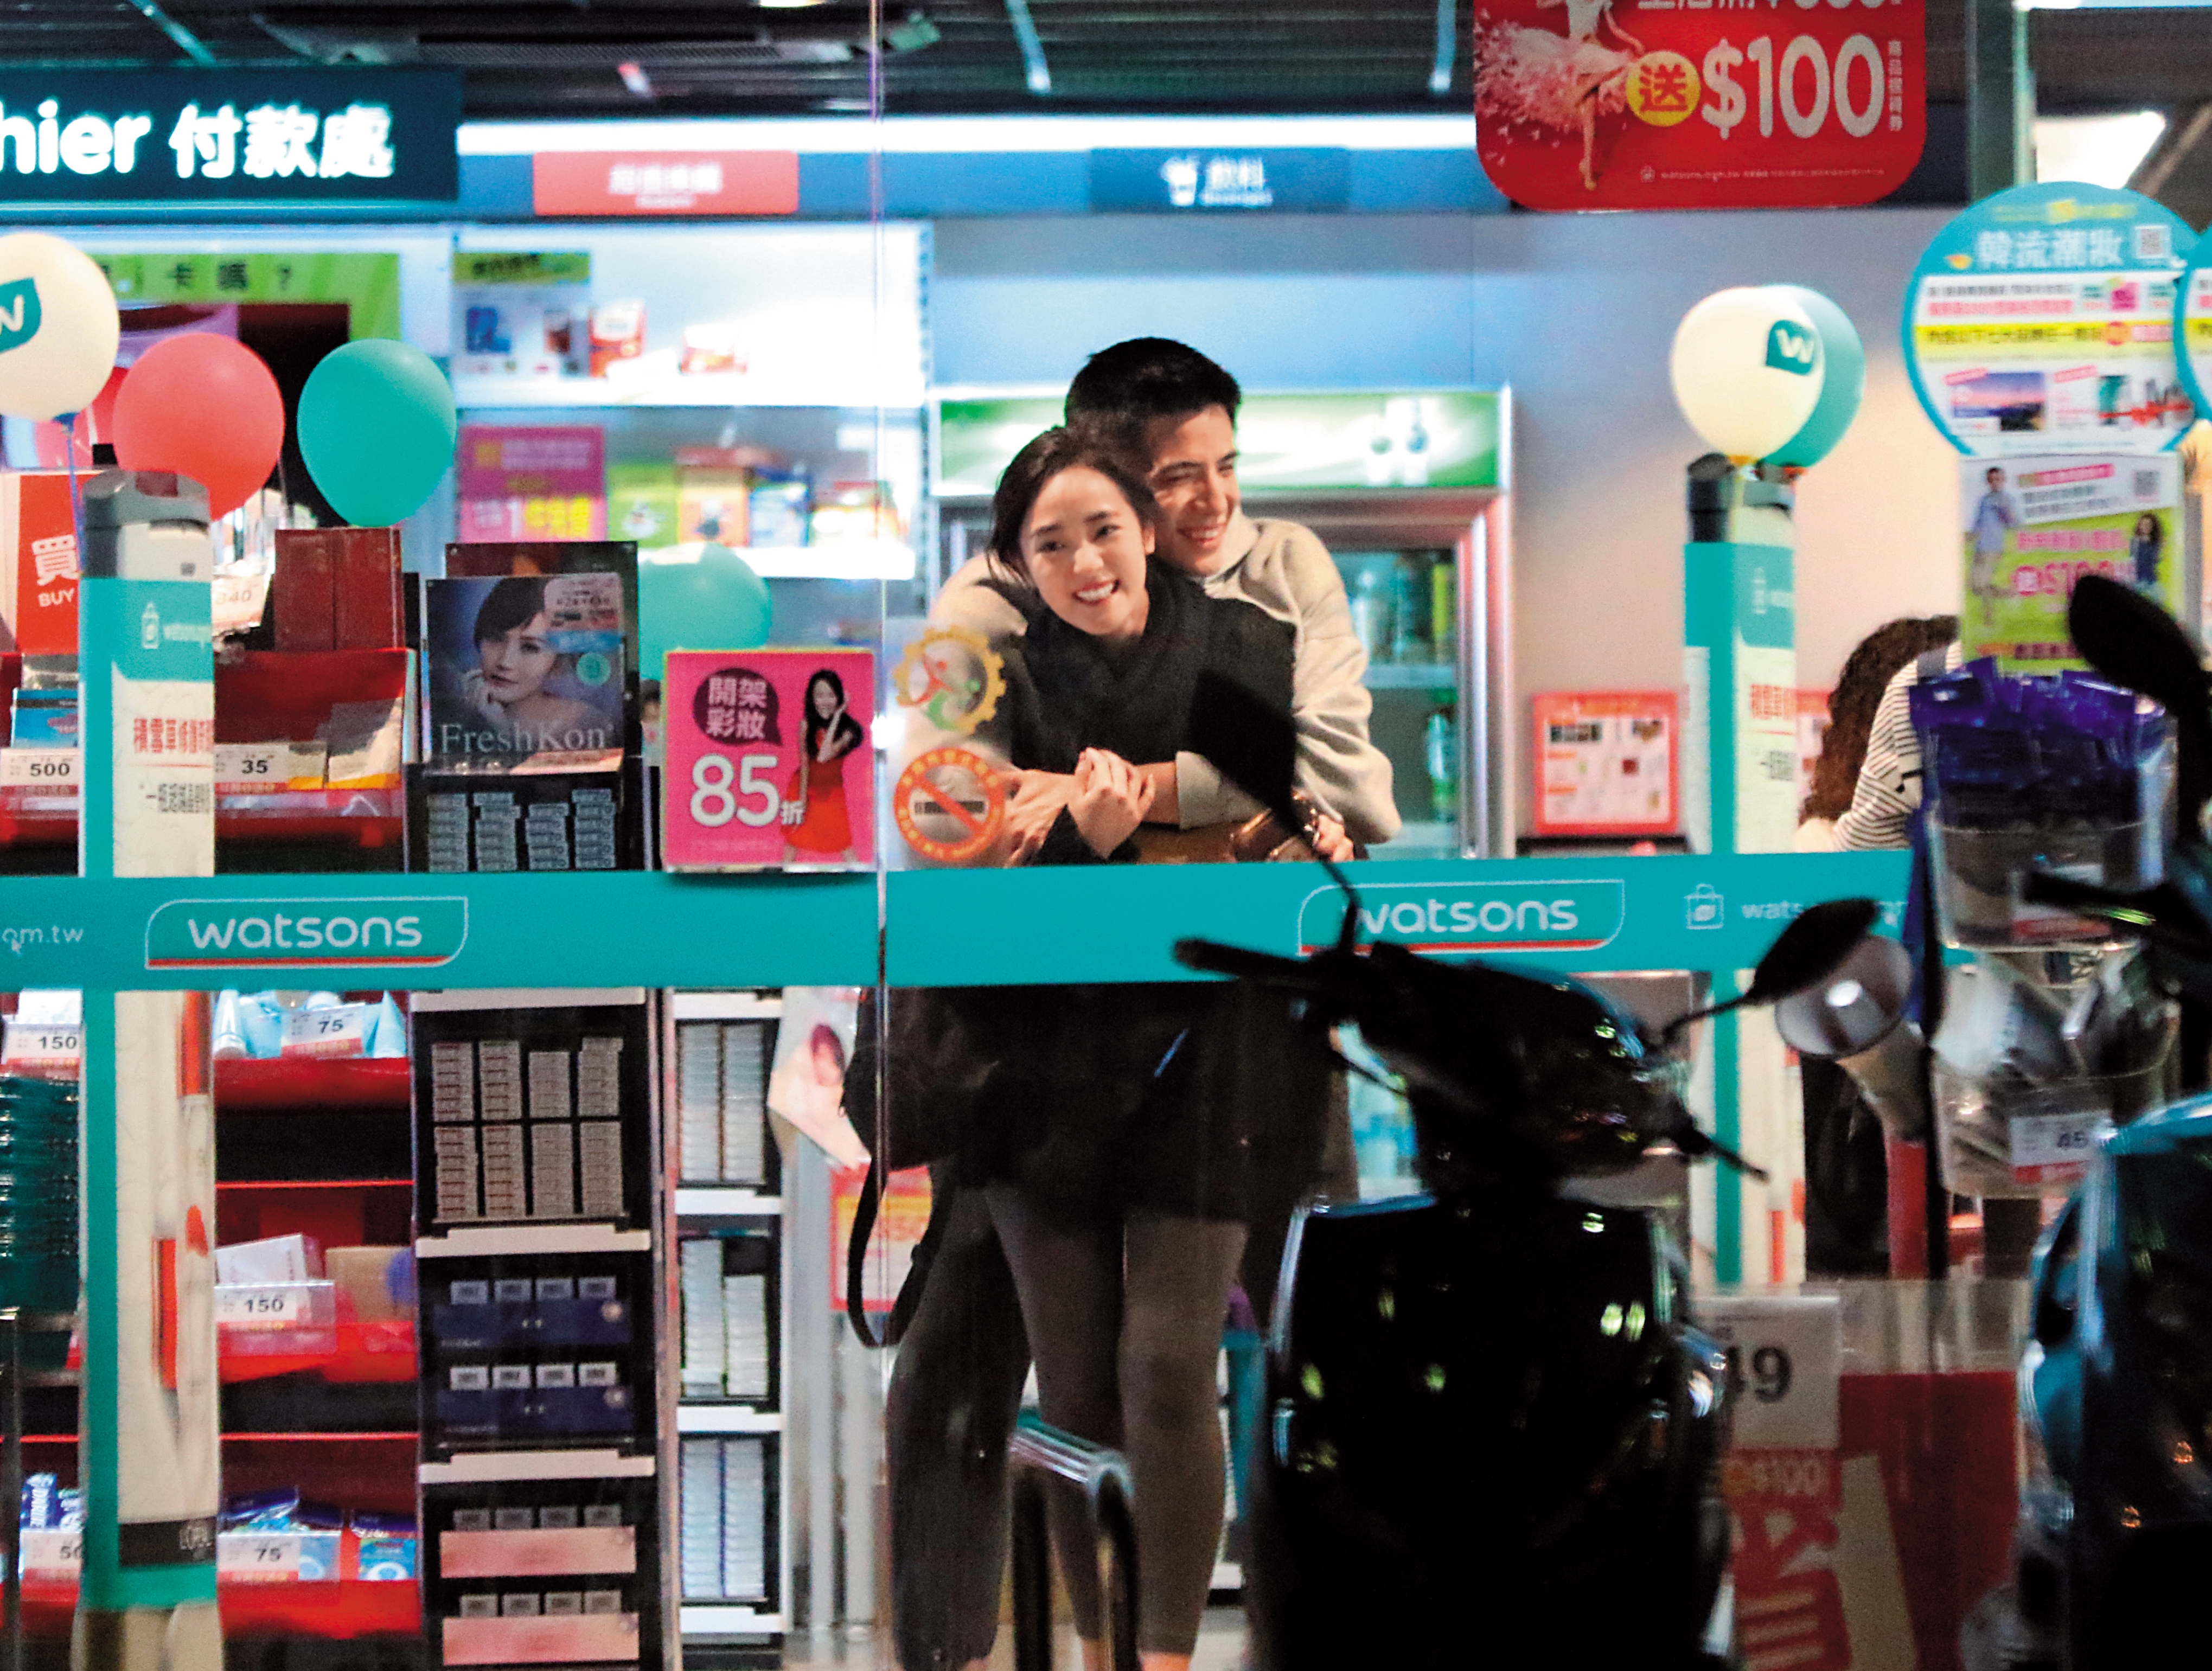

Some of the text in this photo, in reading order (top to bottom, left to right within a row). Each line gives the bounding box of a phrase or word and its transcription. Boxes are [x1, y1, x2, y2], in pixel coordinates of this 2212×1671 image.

[1639, 63, 1688, 112] 送
[1702, 33, 1885, 139] $100
[37, 588, 75, 607] BUY
[707, 676, 767, 708] 開架
[439, 723, 605, 754] FreshKon
[30, 763, 71, 777] 500
[242, 760, 268, 773] 35
[188, 913, 423, 950] watsons
[318, 1019, 344, 1034] 75
[39, 1036, 77, 1049] 150
[244, 1299, 284, 1313] 150
[255, 1547, 281, 1563] 75
